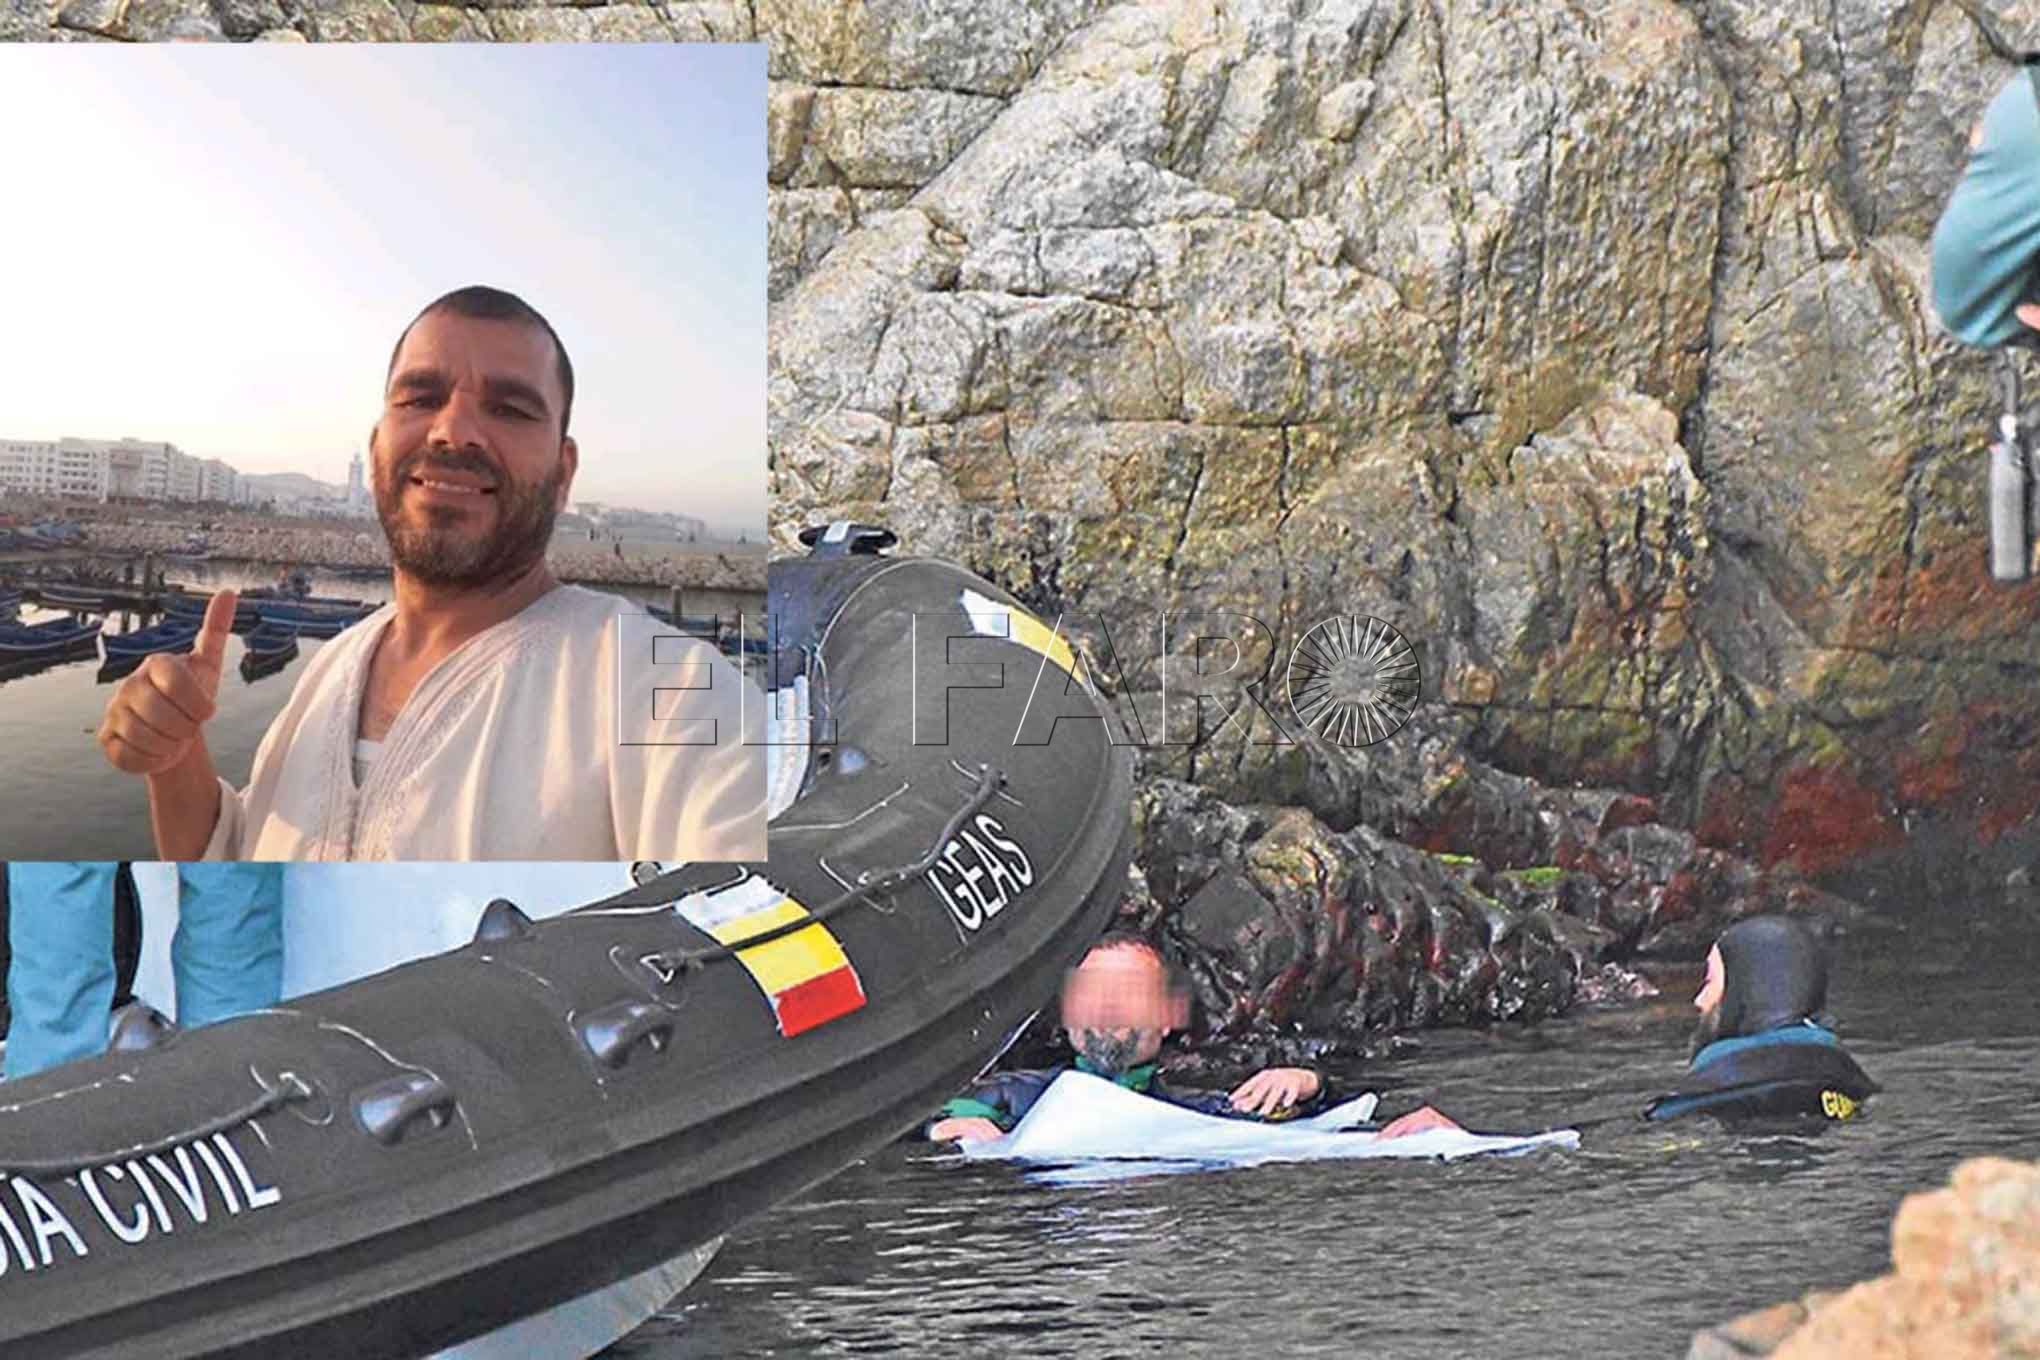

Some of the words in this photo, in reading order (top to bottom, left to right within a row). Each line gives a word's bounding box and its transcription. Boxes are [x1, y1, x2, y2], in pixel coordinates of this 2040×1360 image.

[926, 813, 1035, 931] GEAS
[0, 1174, 89, 1277] IA
[80, 1132, 282, 1243] CIVIL
